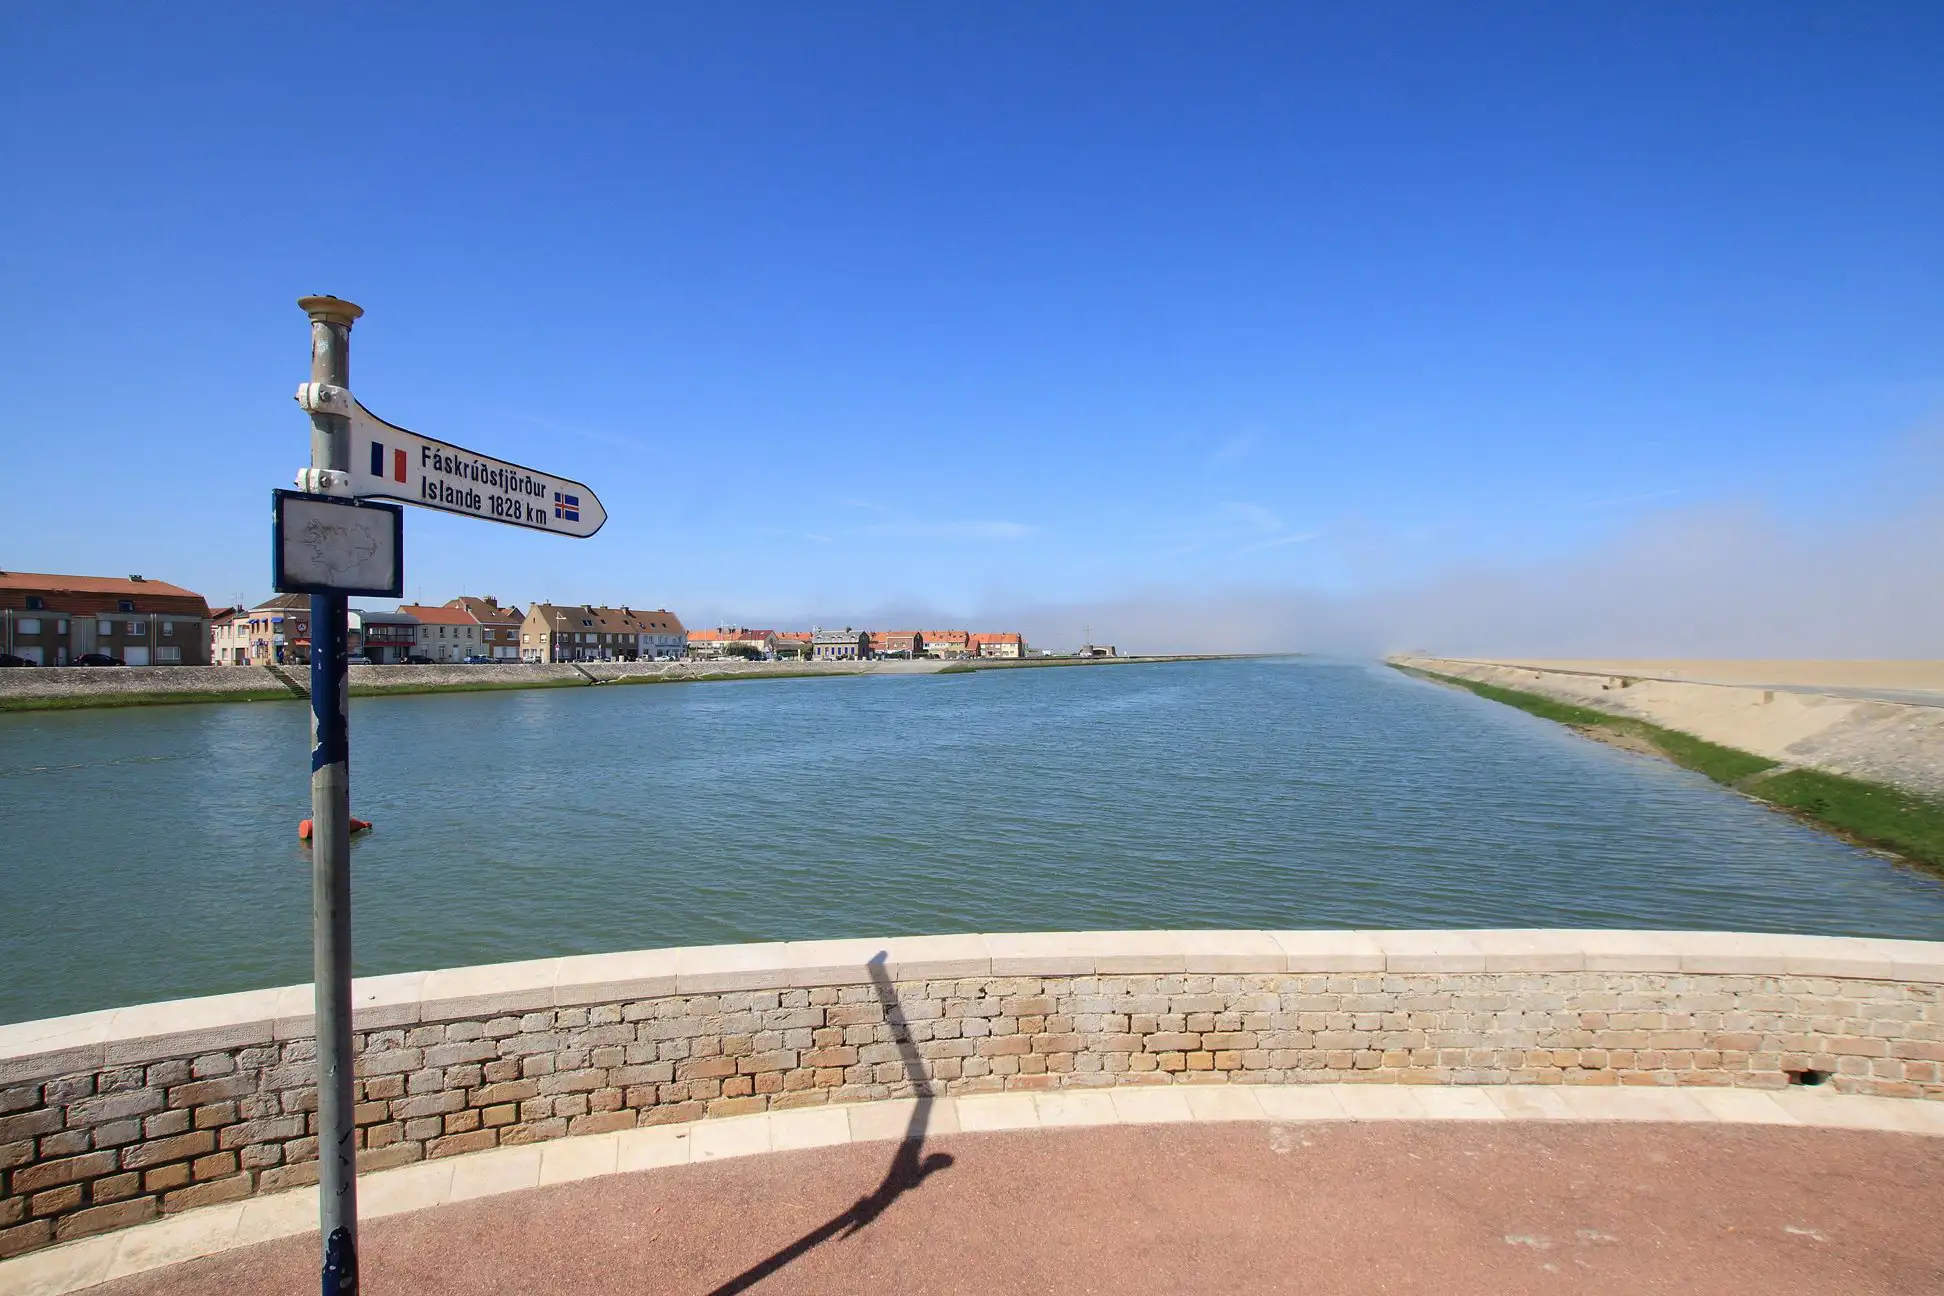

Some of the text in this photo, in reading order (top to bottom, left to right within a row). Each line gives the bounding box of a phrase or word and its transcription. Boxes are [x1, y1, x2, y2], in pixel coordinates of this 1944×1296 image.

[422, 445, 546, 498] Fáskrúðsfjörður
[422, 475, 547, 525] Islande 1828 km
